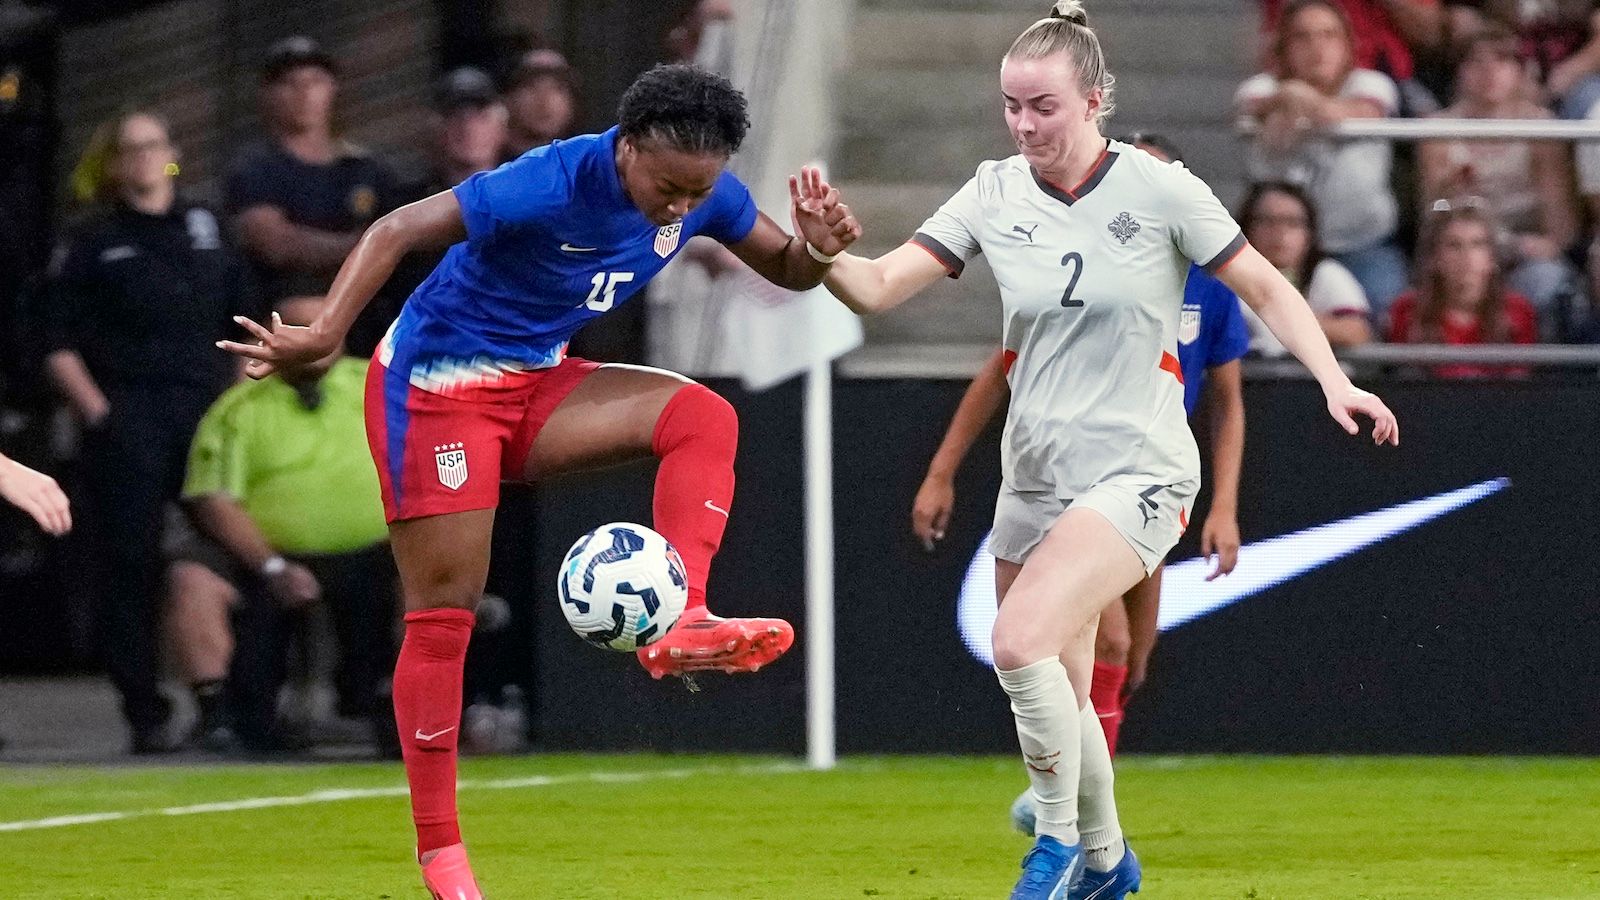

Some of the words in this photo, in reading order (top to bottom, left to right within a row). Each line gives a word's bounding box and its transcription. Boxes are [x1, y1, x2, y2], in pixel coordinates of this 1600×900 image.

[659, 225, 680, 237] USA
[576, 272, 635, 312] 15
[1060, 252, 1084, 307] 2
[438, 452, 463, 467] USA
